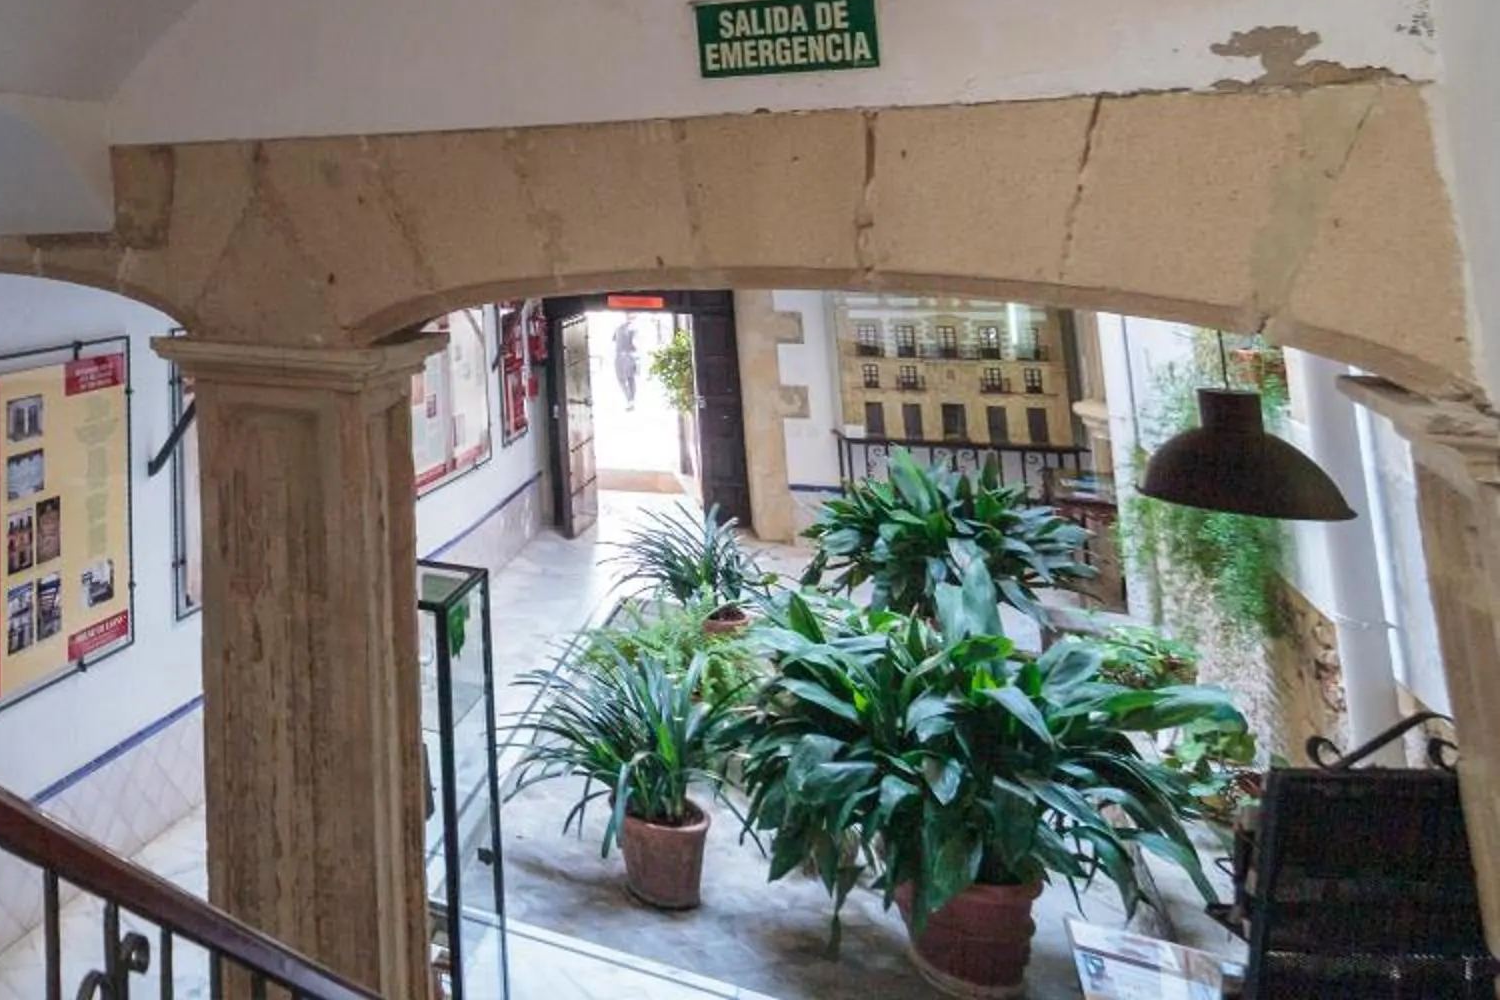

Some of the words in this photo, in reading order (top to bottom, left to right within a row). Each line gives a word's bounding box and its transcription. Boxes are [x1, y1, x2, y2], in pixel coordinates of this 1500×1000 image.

[718, 5, 809, 38] SALIDA
[814, 0, 849, 31] DE
[704, 31, 872, 71] EMERGENCIA
